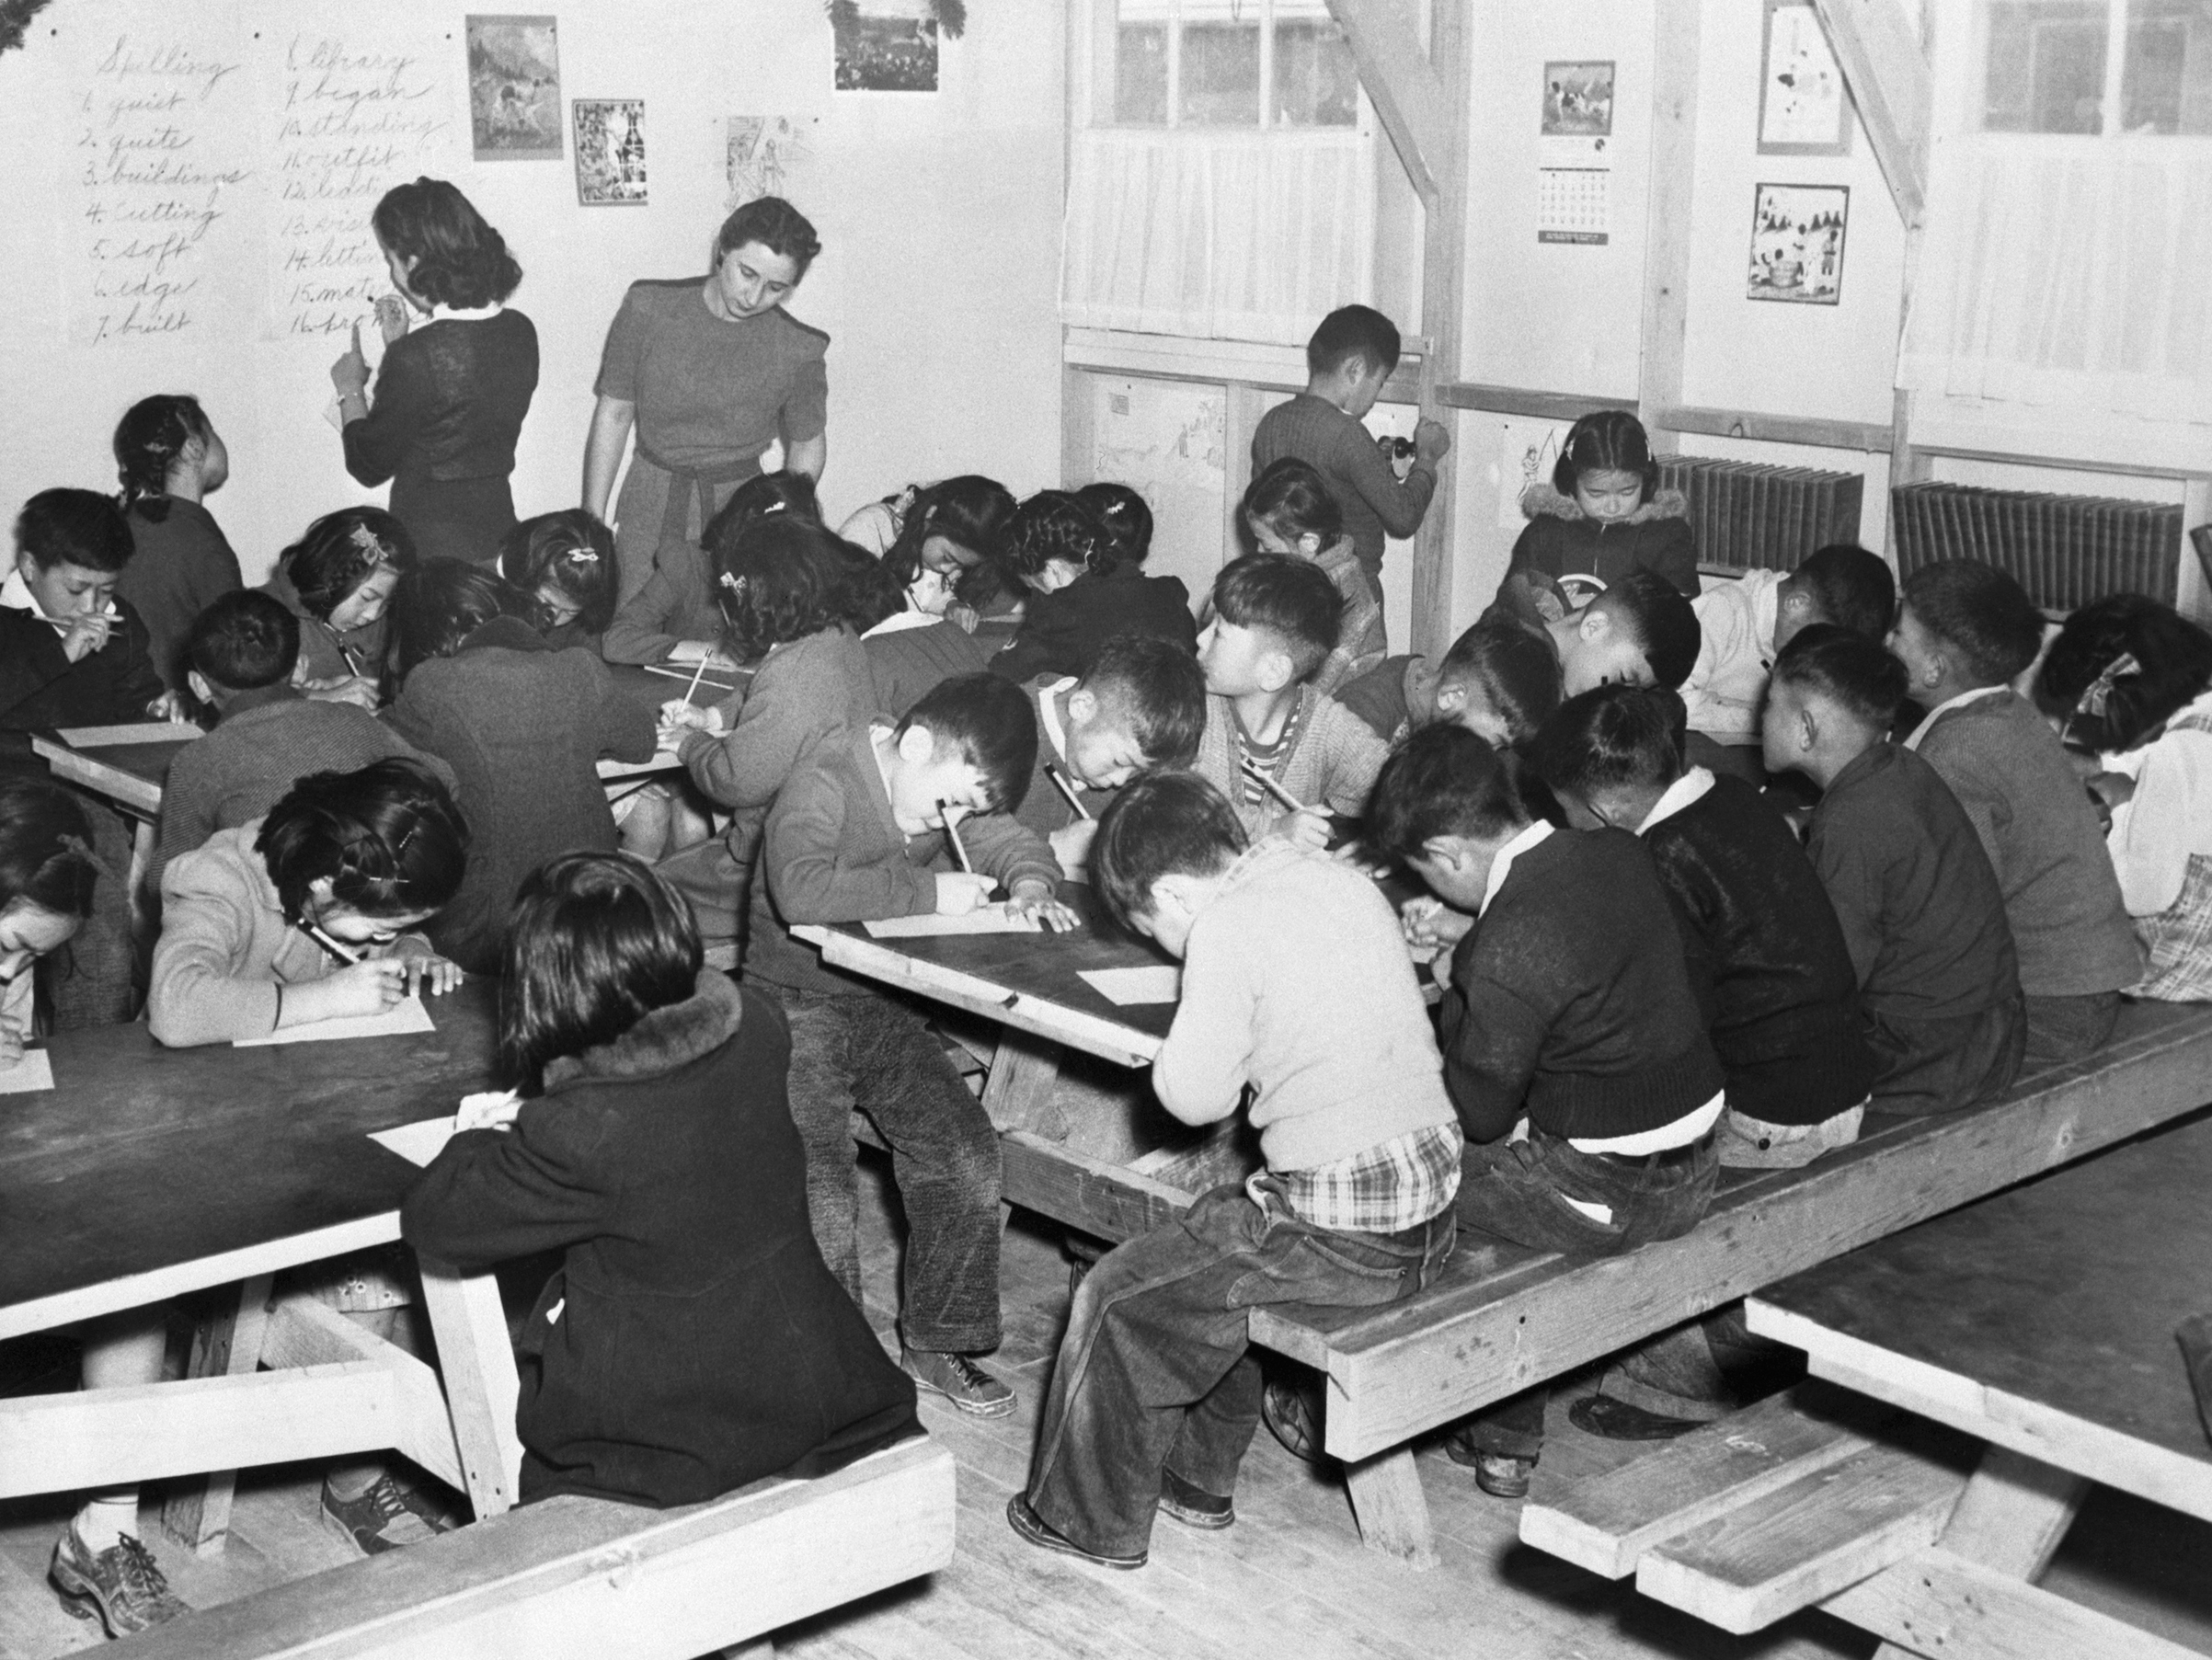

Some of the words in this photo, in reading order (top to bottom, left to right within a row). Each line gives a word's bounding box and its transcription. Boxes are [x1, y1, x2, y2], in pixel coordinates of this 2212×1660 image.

[96, 33, 240, 101] Spelling
[305, 38, 416, 90] library
[106, 90, 186, 130] quiet
[303, 79, 434, 129] began
[77, 127, 97, 148] 2.
[107, 125, 194, 167] quite
[281, 151, 300, 171] 11.
[305, 145, 404, 188] outfit
[82, 160, 98, 186] 3.
[101, 154, 257, 208] buildings
[85, 201, 107, 224] 4.
[88, 239, 110, 259] 5.
[113, 232, 191, 276] soft
[284, 248, 308, 272] 14.
[112, 273, 199, 318] edge
[290, 282, 315, 306] 15.
[92, 315, 110, 347] 7.
[113, 301, 191, 335] built
[290, 311, 313, 333] 16.
